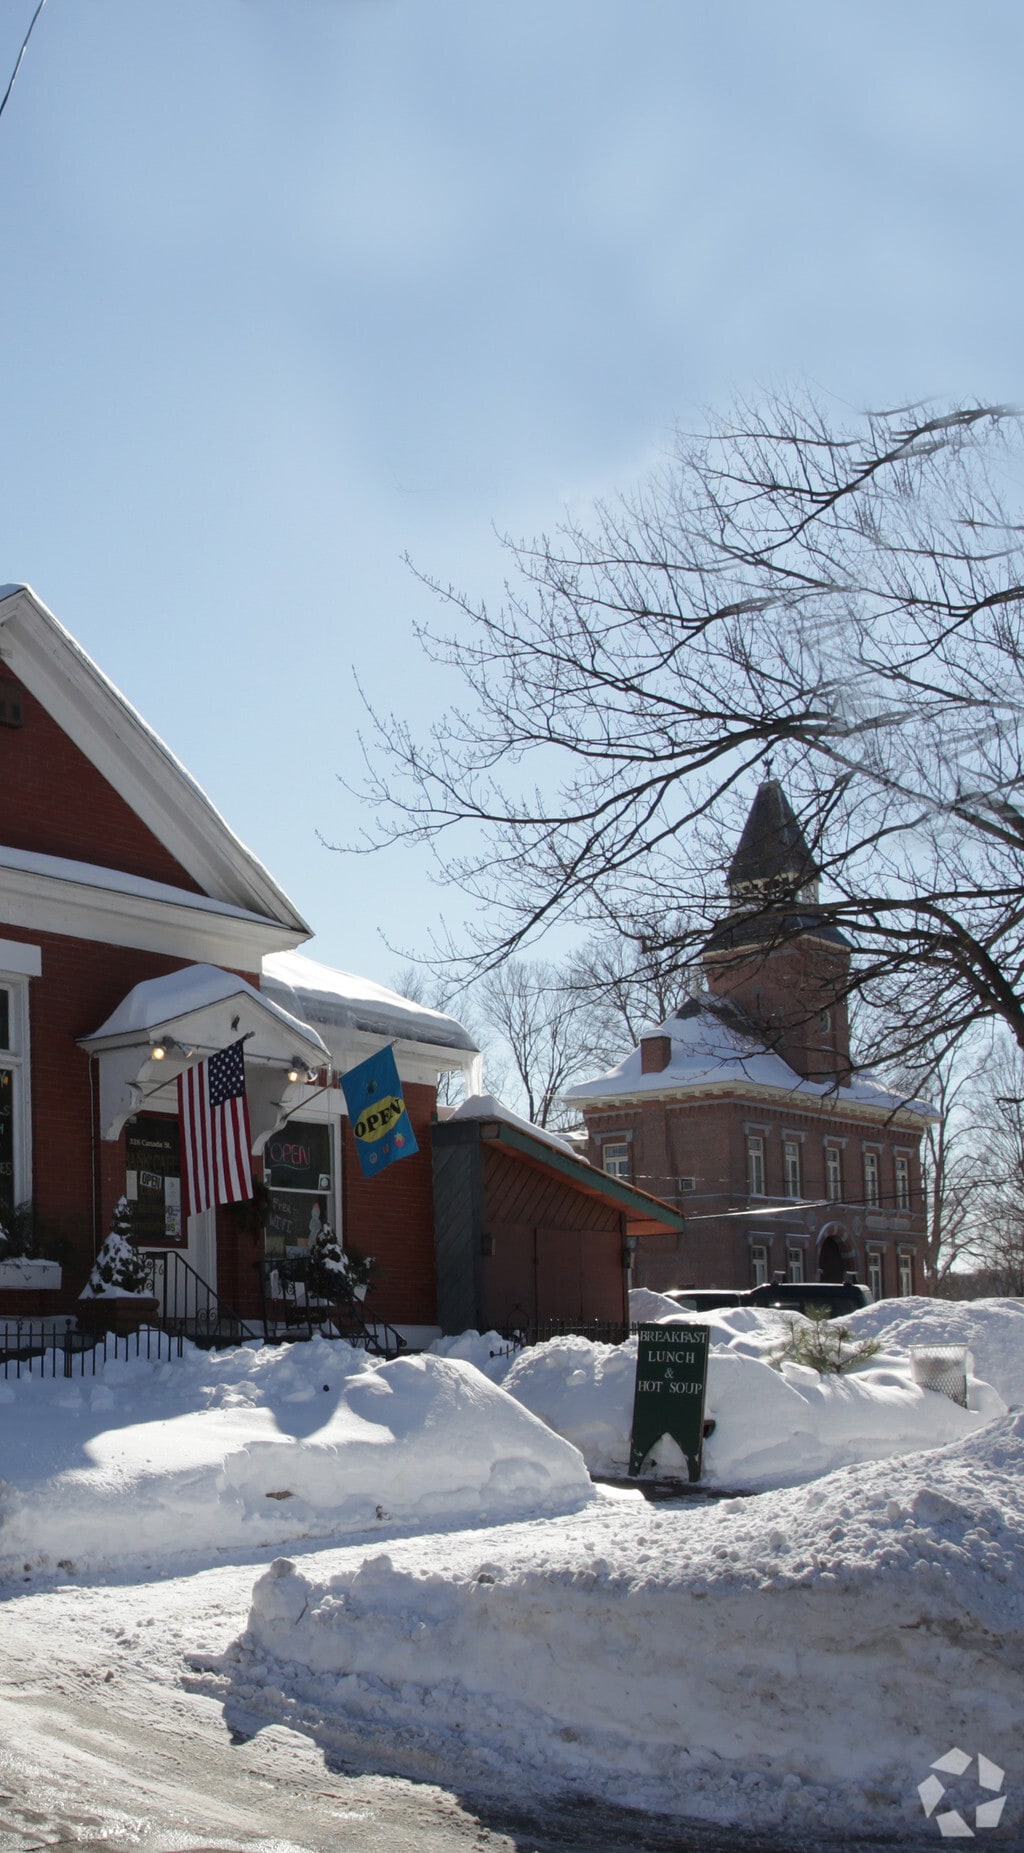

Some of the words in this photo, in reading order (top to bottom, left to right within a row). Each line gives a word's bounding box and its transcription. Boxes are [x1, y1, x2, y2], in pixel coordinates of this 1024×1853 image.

[354, 1098, 402, 1138] OPEN
[270, 1142, 311, 1166] OPEN
[141, 1172, 161, 1189] OPEN
[639, 1330, 707, 1344] BREAKFAST
[647, 1350, 696, 1364] LUNCH
[664, 1367, 674, 1379] &
[637, 1380, 663, 1393] HOT
[668, 1381, 703, 1395] SOUP
